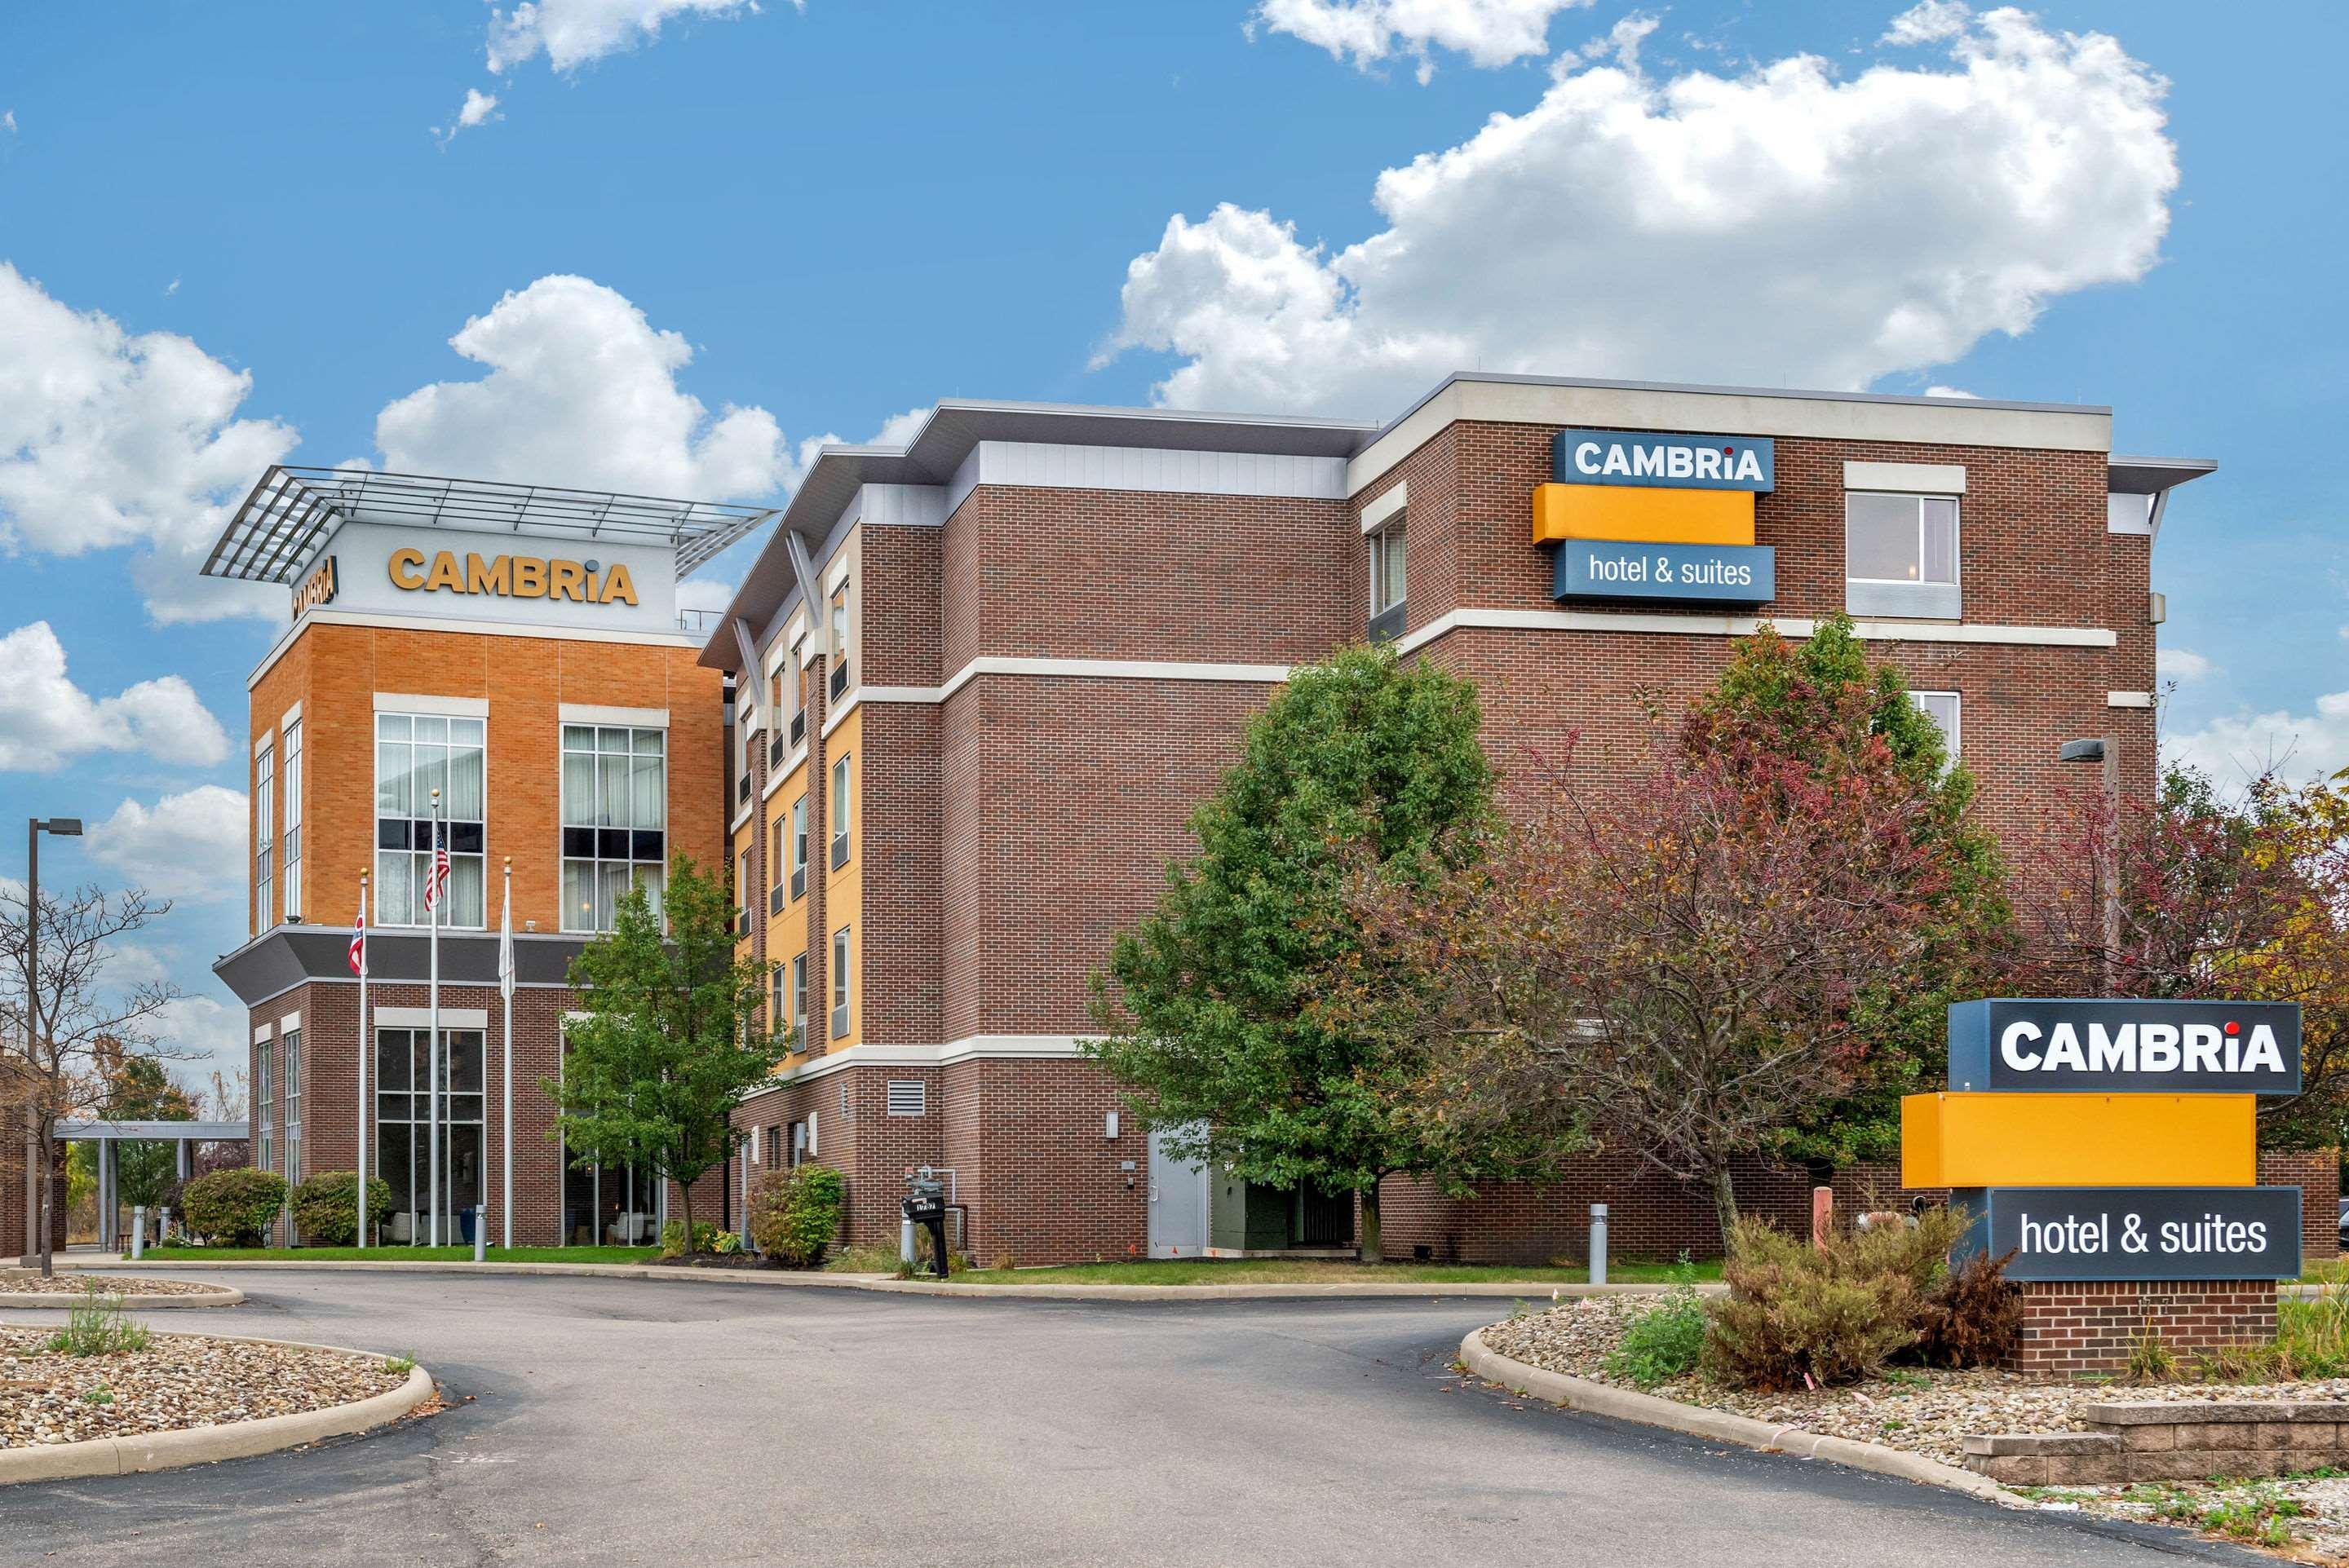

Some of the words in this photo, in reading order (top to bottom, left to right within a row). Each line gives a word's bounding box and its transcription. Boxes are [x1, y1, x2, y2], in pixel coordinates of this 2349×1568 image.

[1575, 442, 1764, 481] CAMBRiA
[389, 547, 639, 606] CAMBRiA
[1590, 554, 1647, 581] hotel
[1655, 557, 1674, 583] &
[1681, 559, 1751, 585] suites
[2001, 1020, 2286, 1073] CAMBRiA
[2021, 1212, 2108, 1254] hotel
[2121, 1212, 2149, 1253] &
[2160, 1213, 2267, 1253] suites
